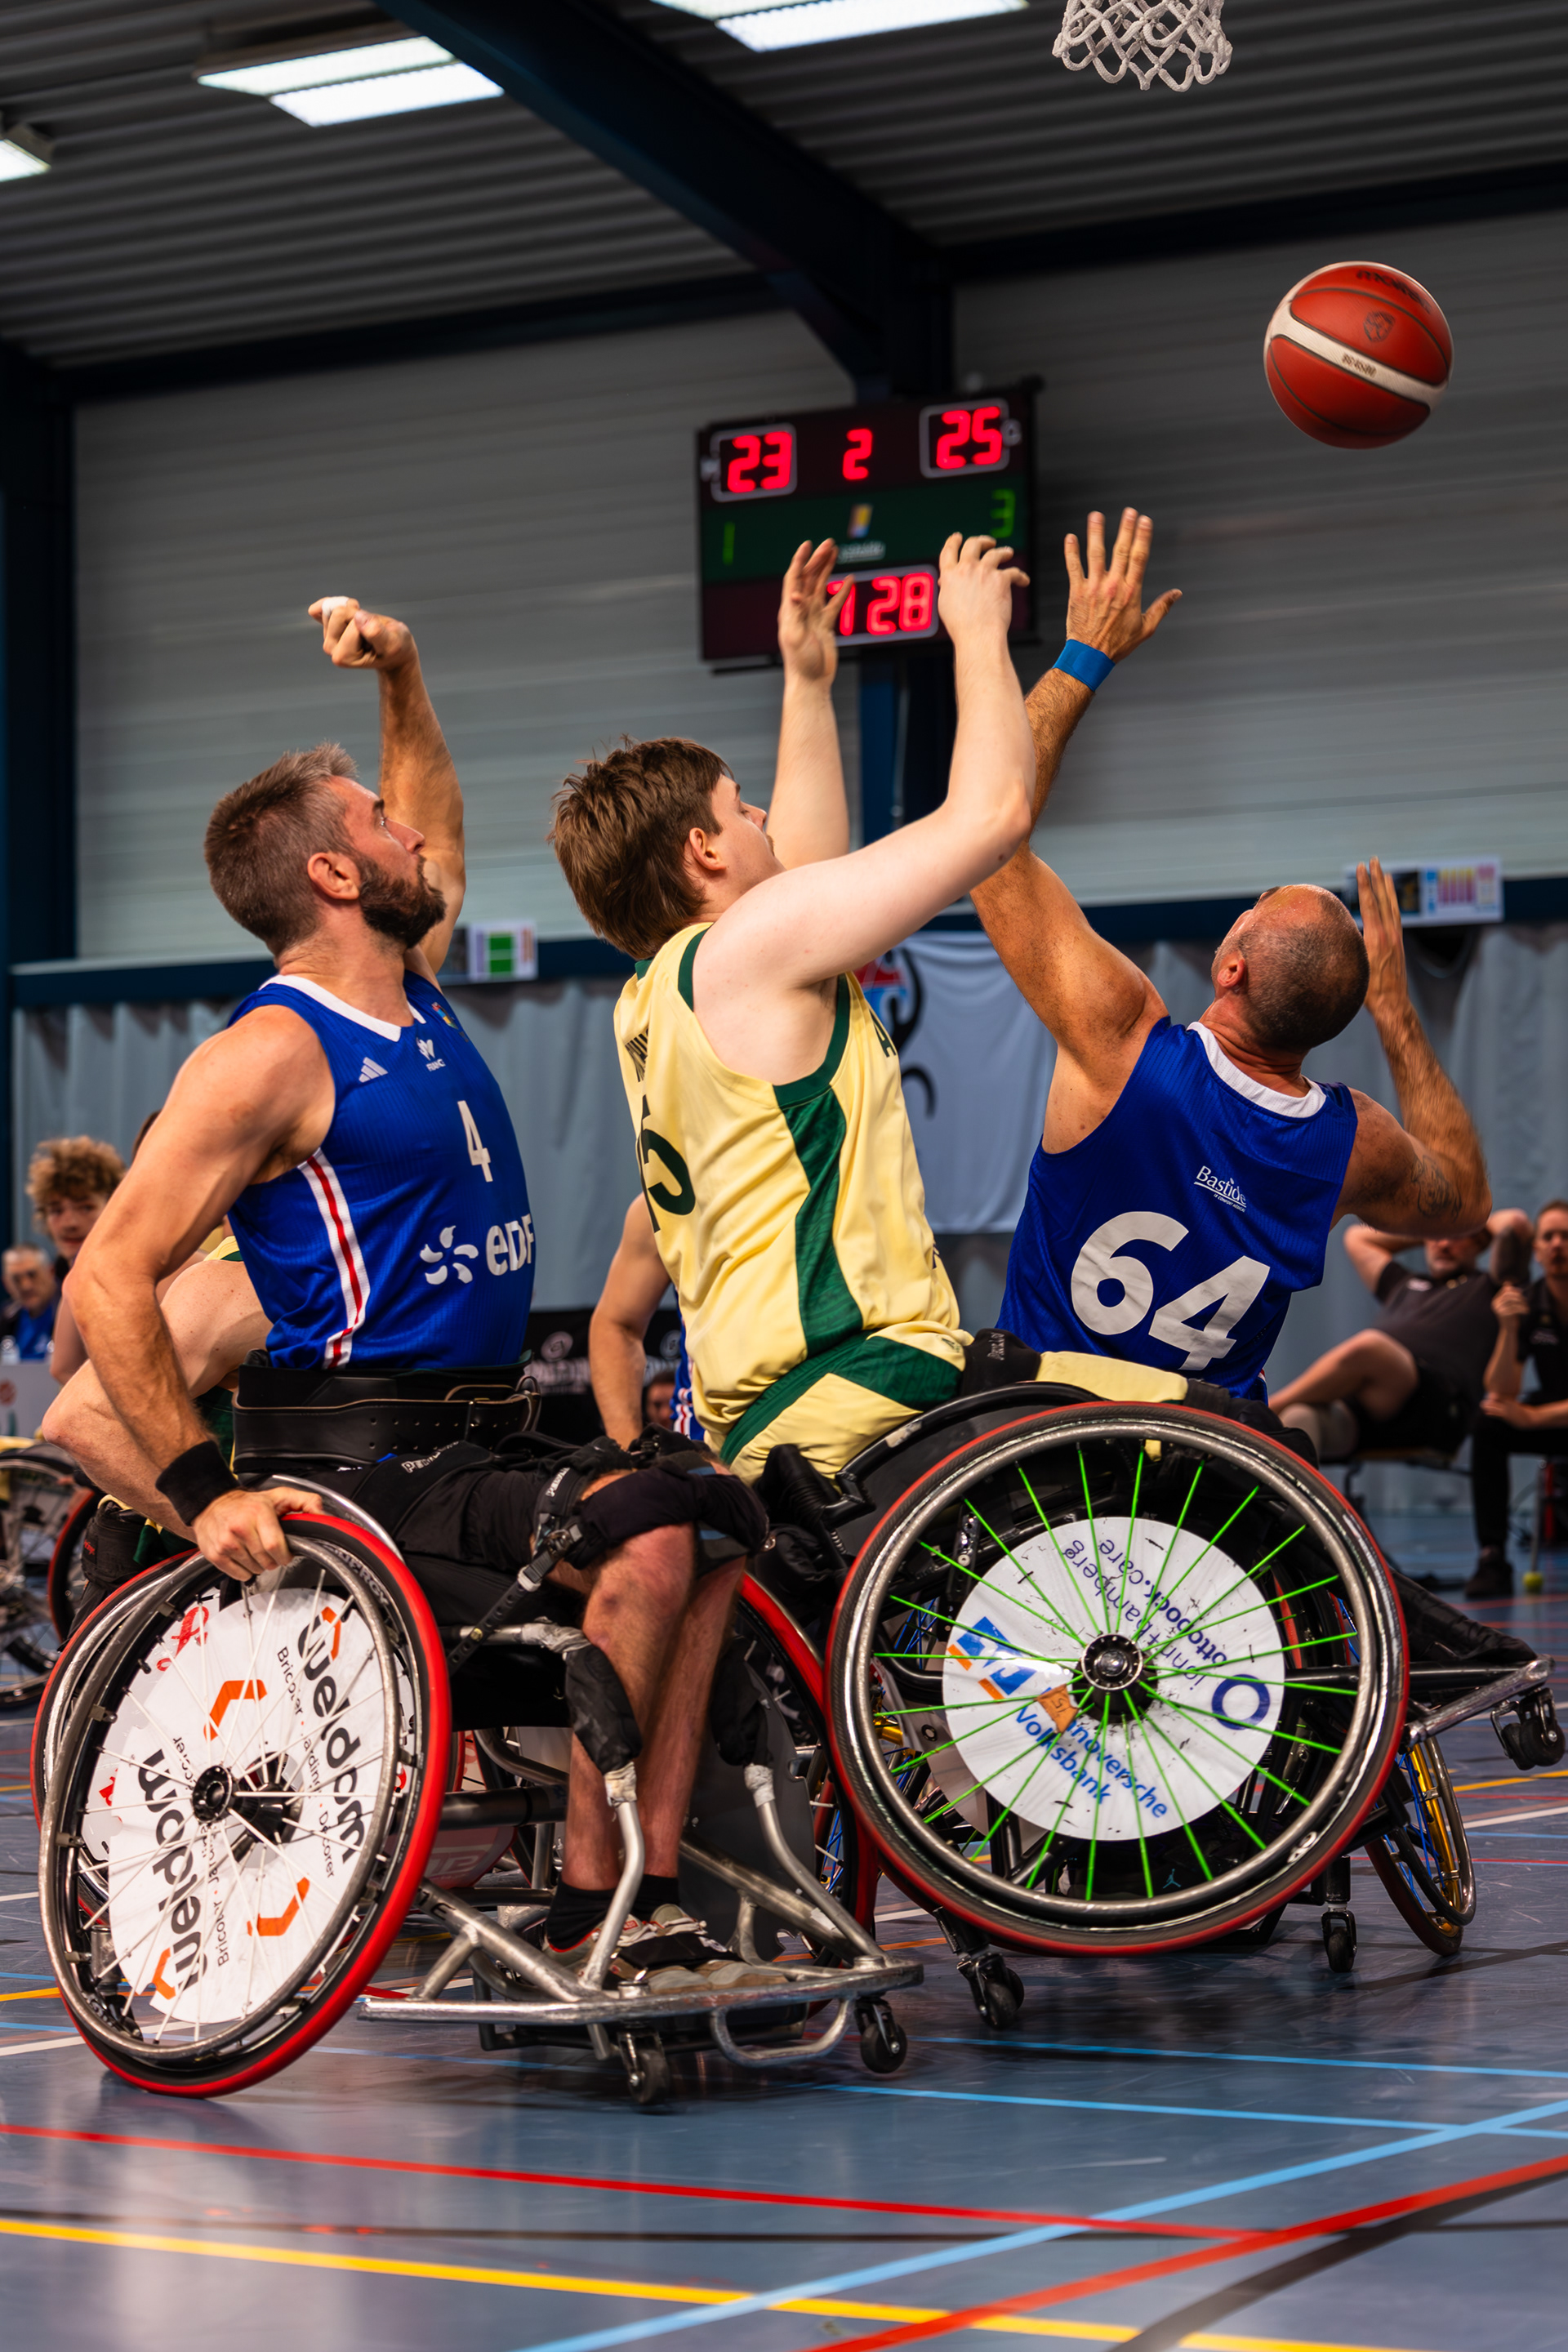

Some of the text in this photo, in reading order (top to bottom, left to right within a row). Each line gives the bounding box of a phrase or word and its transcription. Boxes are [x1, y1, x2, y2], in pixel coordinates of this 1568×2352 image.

[727, 406, 1004, 493] 23 2 25
[990, 488, 1016, 539] 3
[866, 572, 935, 635] 28
[457, 1099, 494, 1183] 4
[1196, 1165, 1246, 1205] Bastide
[1071, 1211, 1271, 1370] 64
[1015, 1705, 1111, 1804] Volksbank
